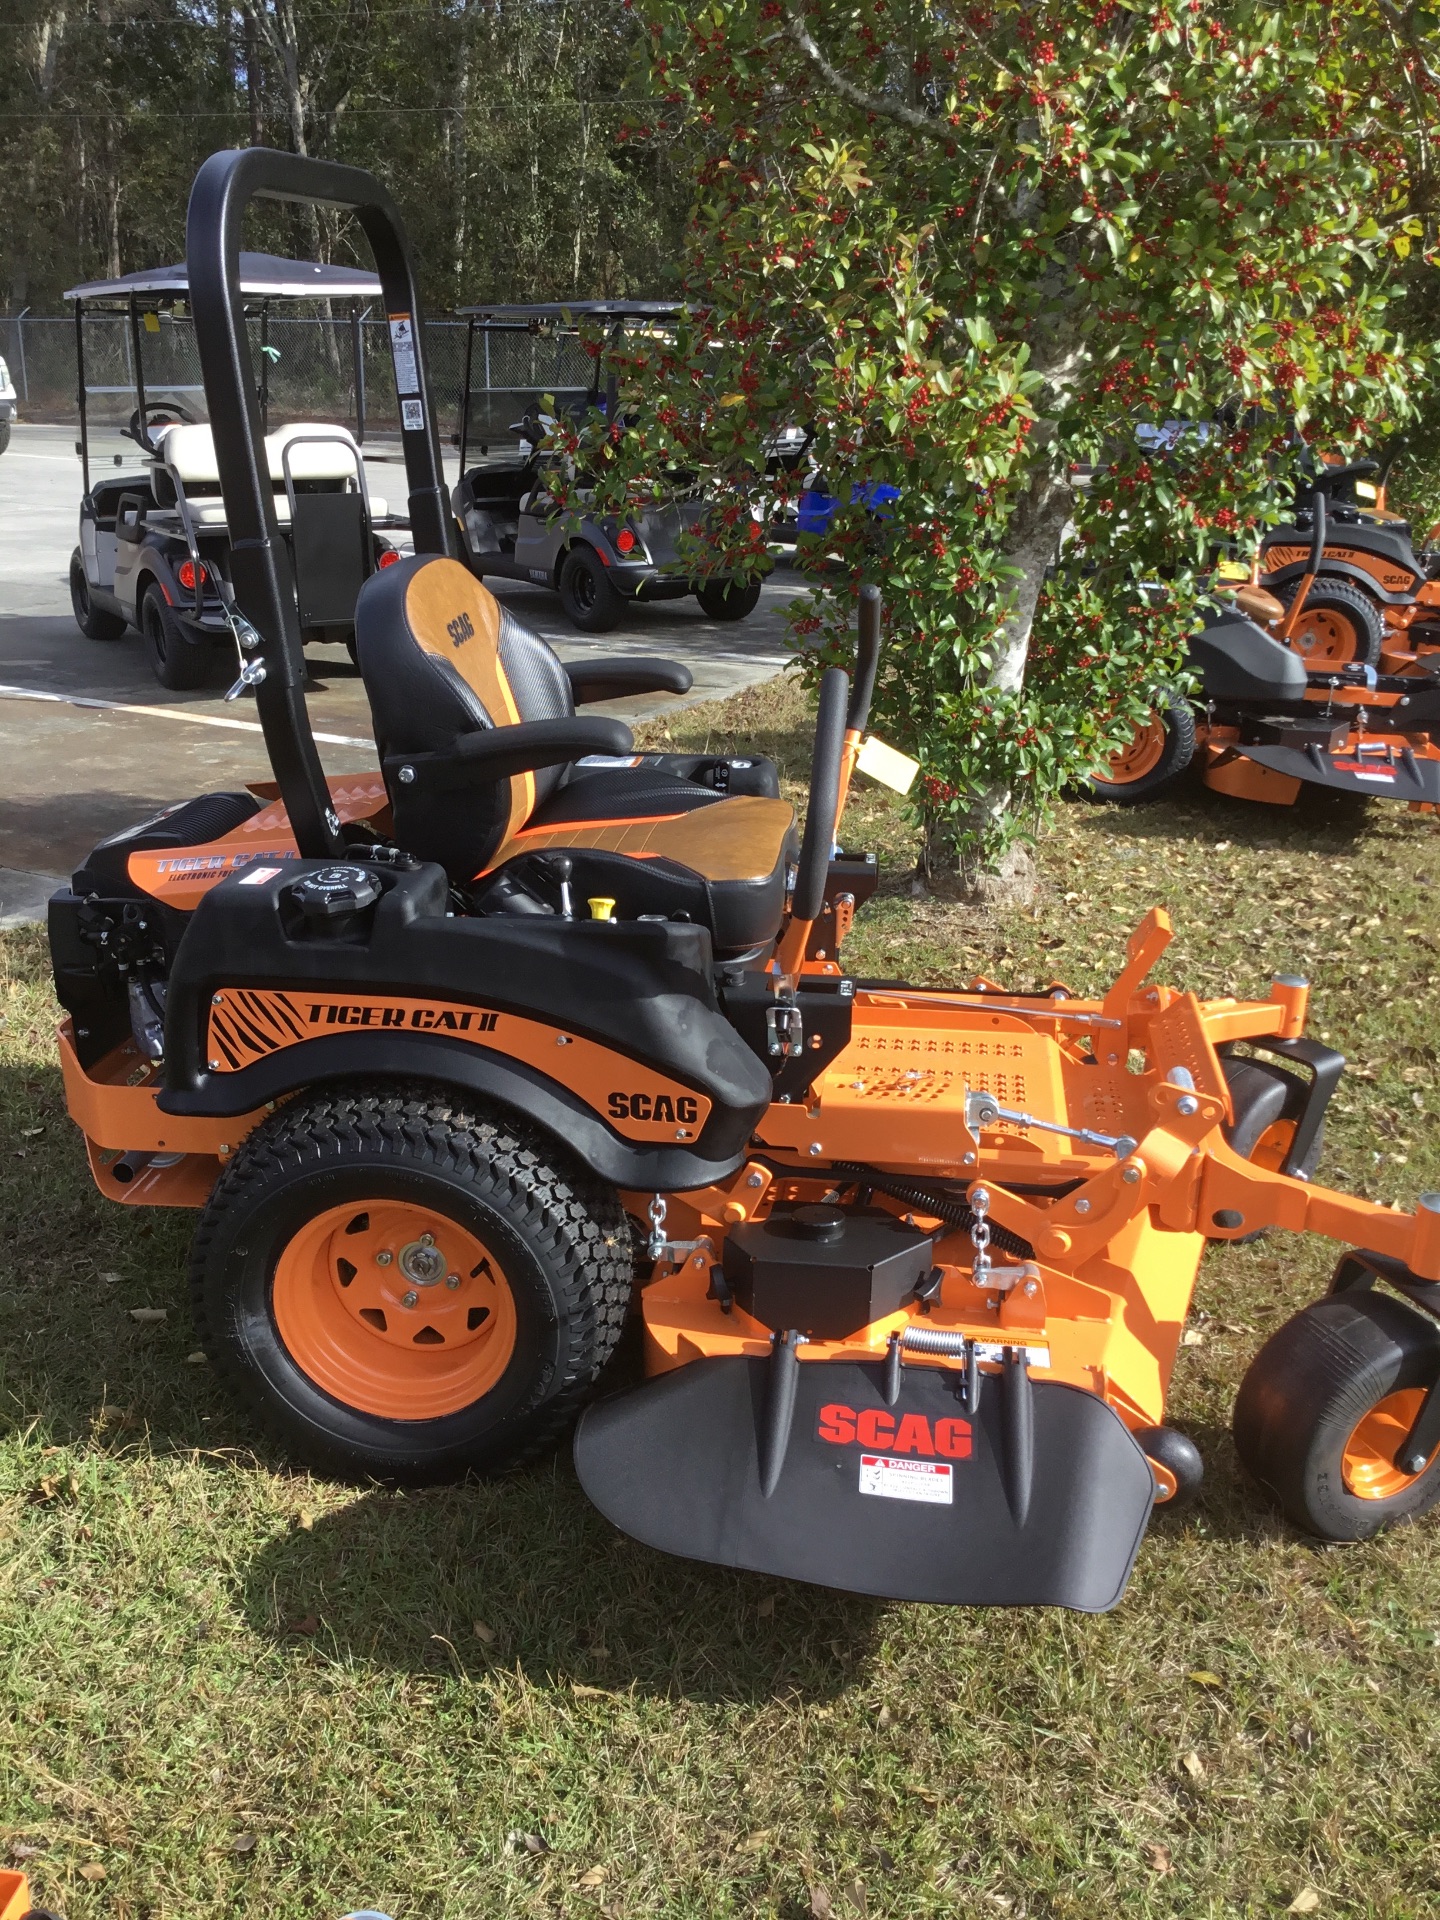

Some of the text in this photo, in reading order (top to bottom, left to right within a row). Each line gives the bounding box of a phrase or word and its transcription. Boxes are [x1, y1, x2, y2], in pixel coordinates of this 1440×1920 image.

[1383, 575, 1411, 585] SCAG
[446, 611, 475, 648] SCAG
[157, 854, 226, 873] TIGER
[168, 870, 215, 882] ELECTRONIC
[318, 883, 349, 891] OVERFILL
[305, 1003, 406, 1027] TIGER
[411, 1009, 479, 1031] CAT
[607, 1091, 698, 1124] SCAG
[980, 1337, 1028, 1346] WARNING
[818, 1402, 973, 1459] SCAG
[888, 1459, 936, 1474] DANGER
